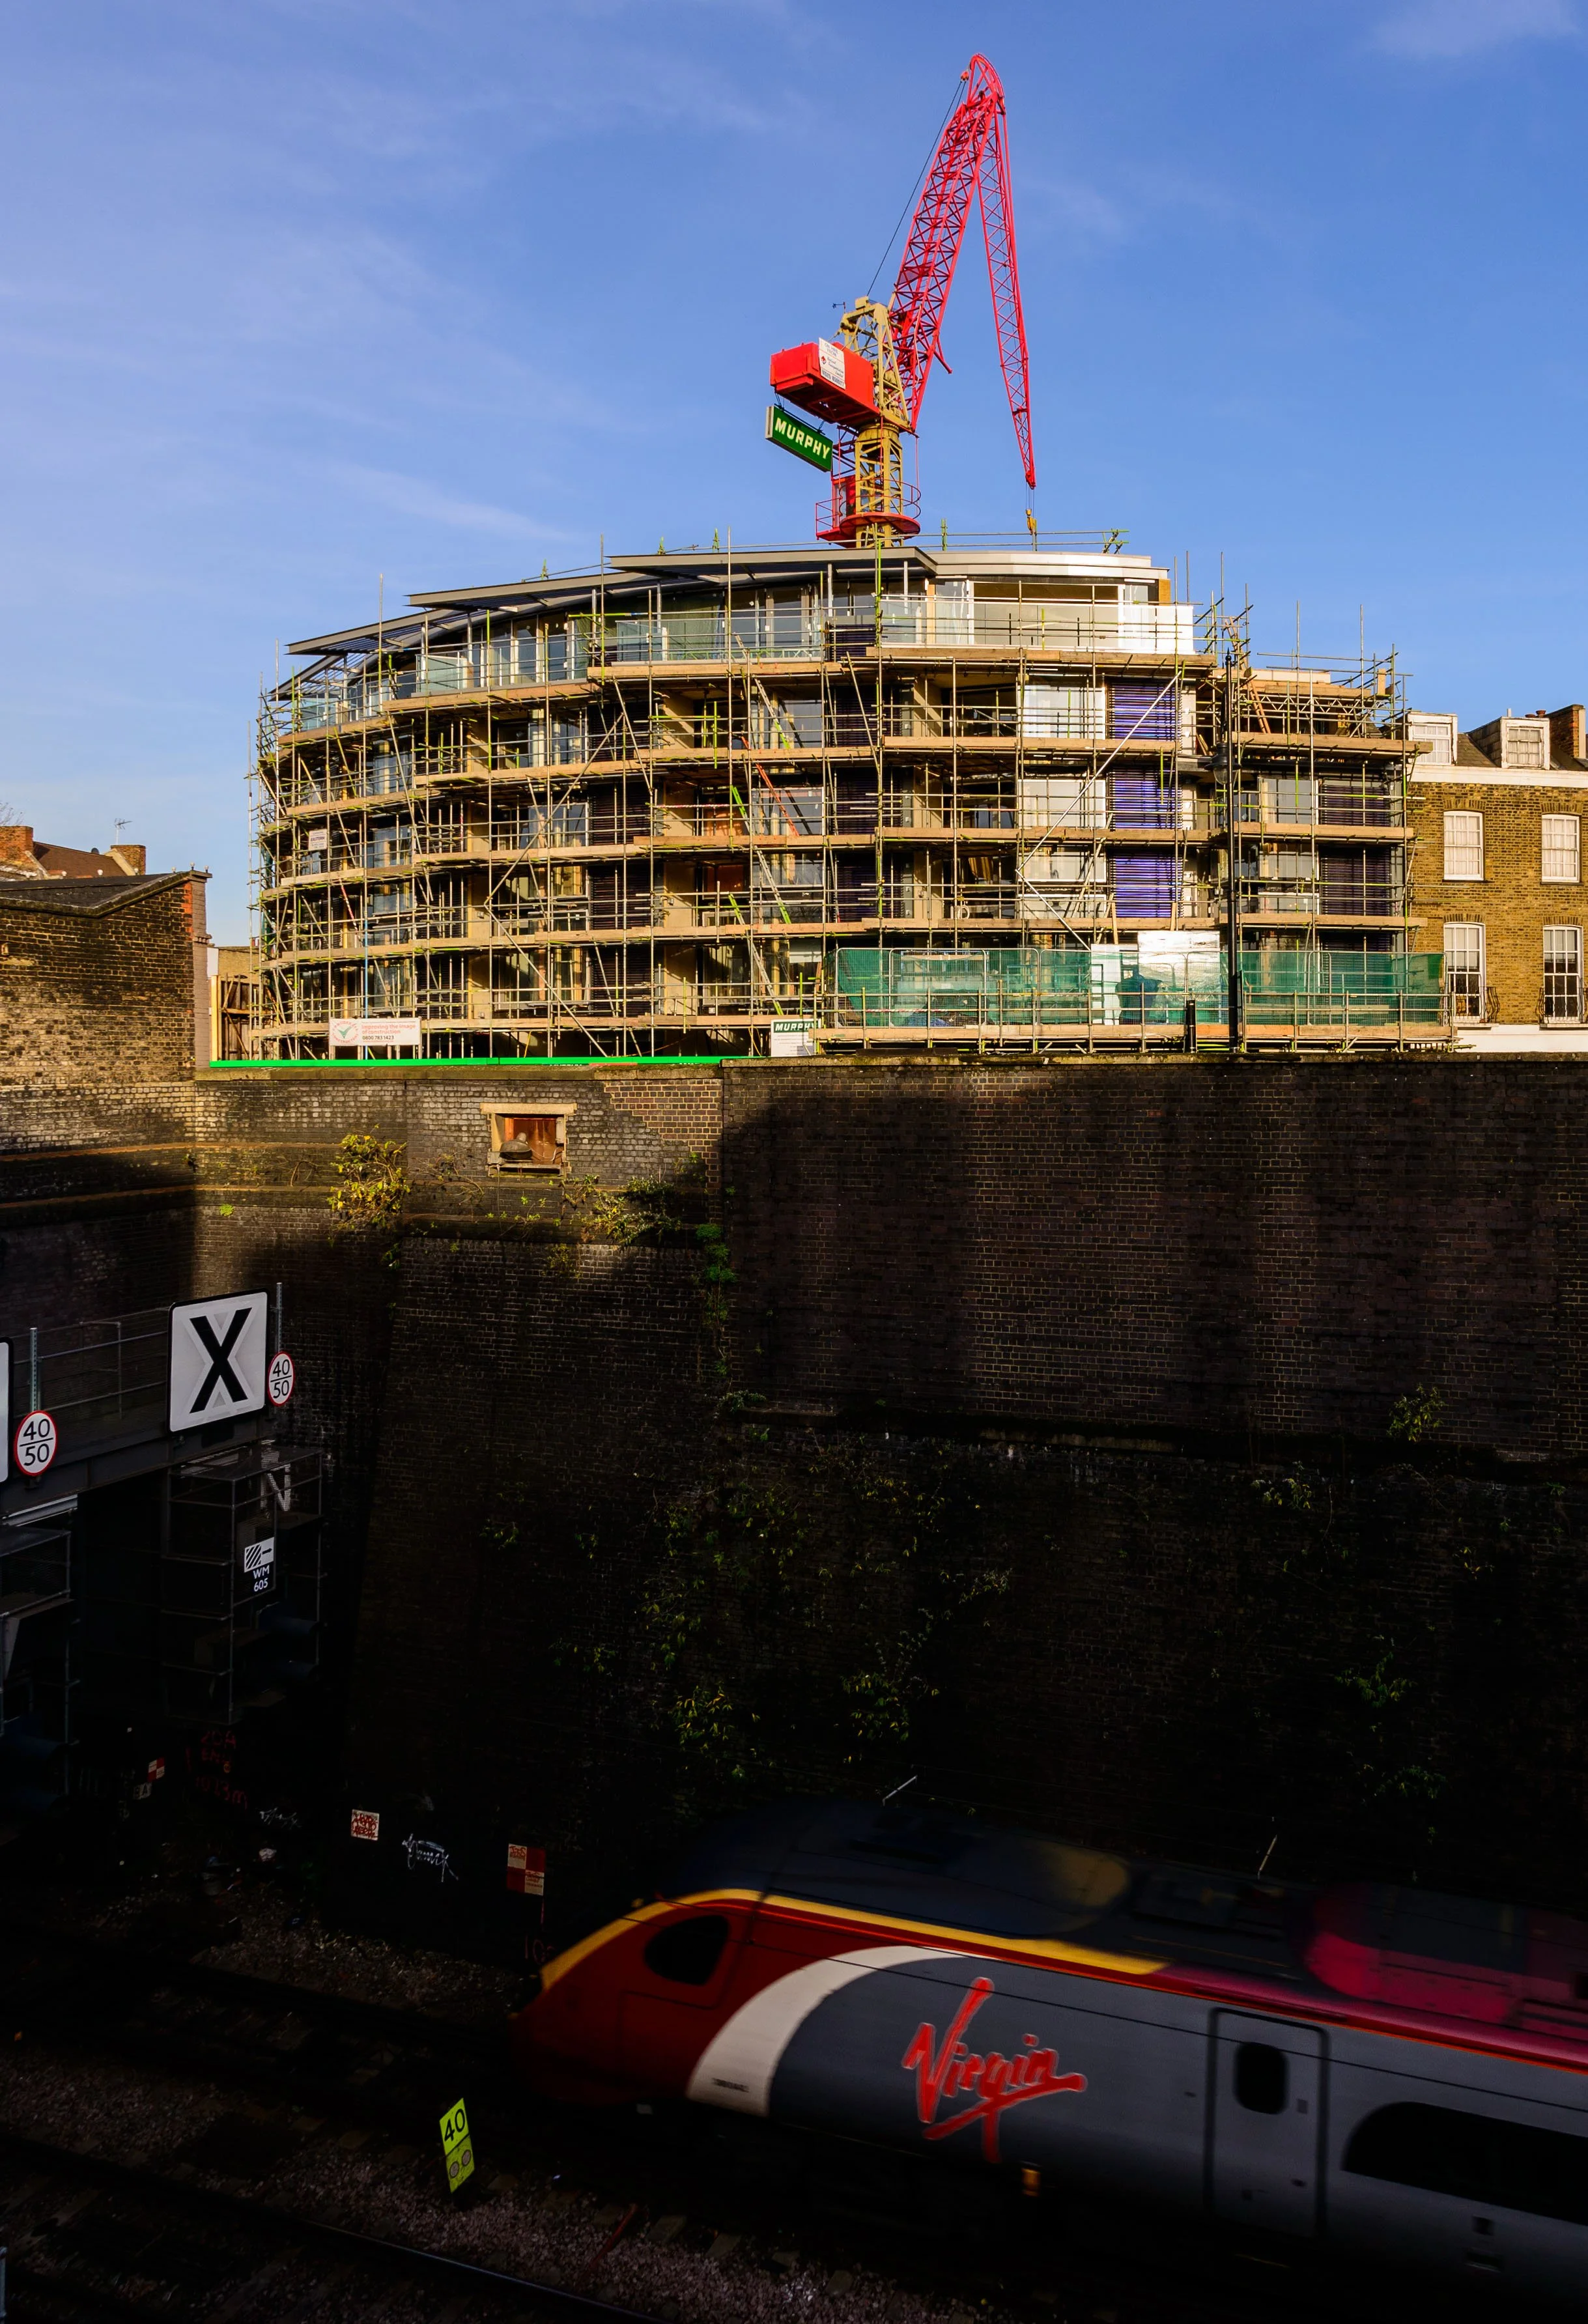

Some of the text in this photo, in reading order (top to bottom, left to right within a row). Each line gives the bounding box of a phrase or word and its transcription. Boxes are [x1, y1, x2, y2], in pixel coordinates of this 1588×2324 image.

[775, 417, 830, 459] MURPHY
[189, 1307, 253, 1414] X
[272, 1359, 291, 1378] 40
[273, 1380, 290, 1399] 50
[23, 1418, 51, 1441] 40
[23, 1443, 50, 1466] 50
[253, 1565, 270, 1580] WM
[253, 1578, 268, 1592] 605
[901, 1977, 1088, 2163] Virgin
[444, 2108, 466, 2142] 40
